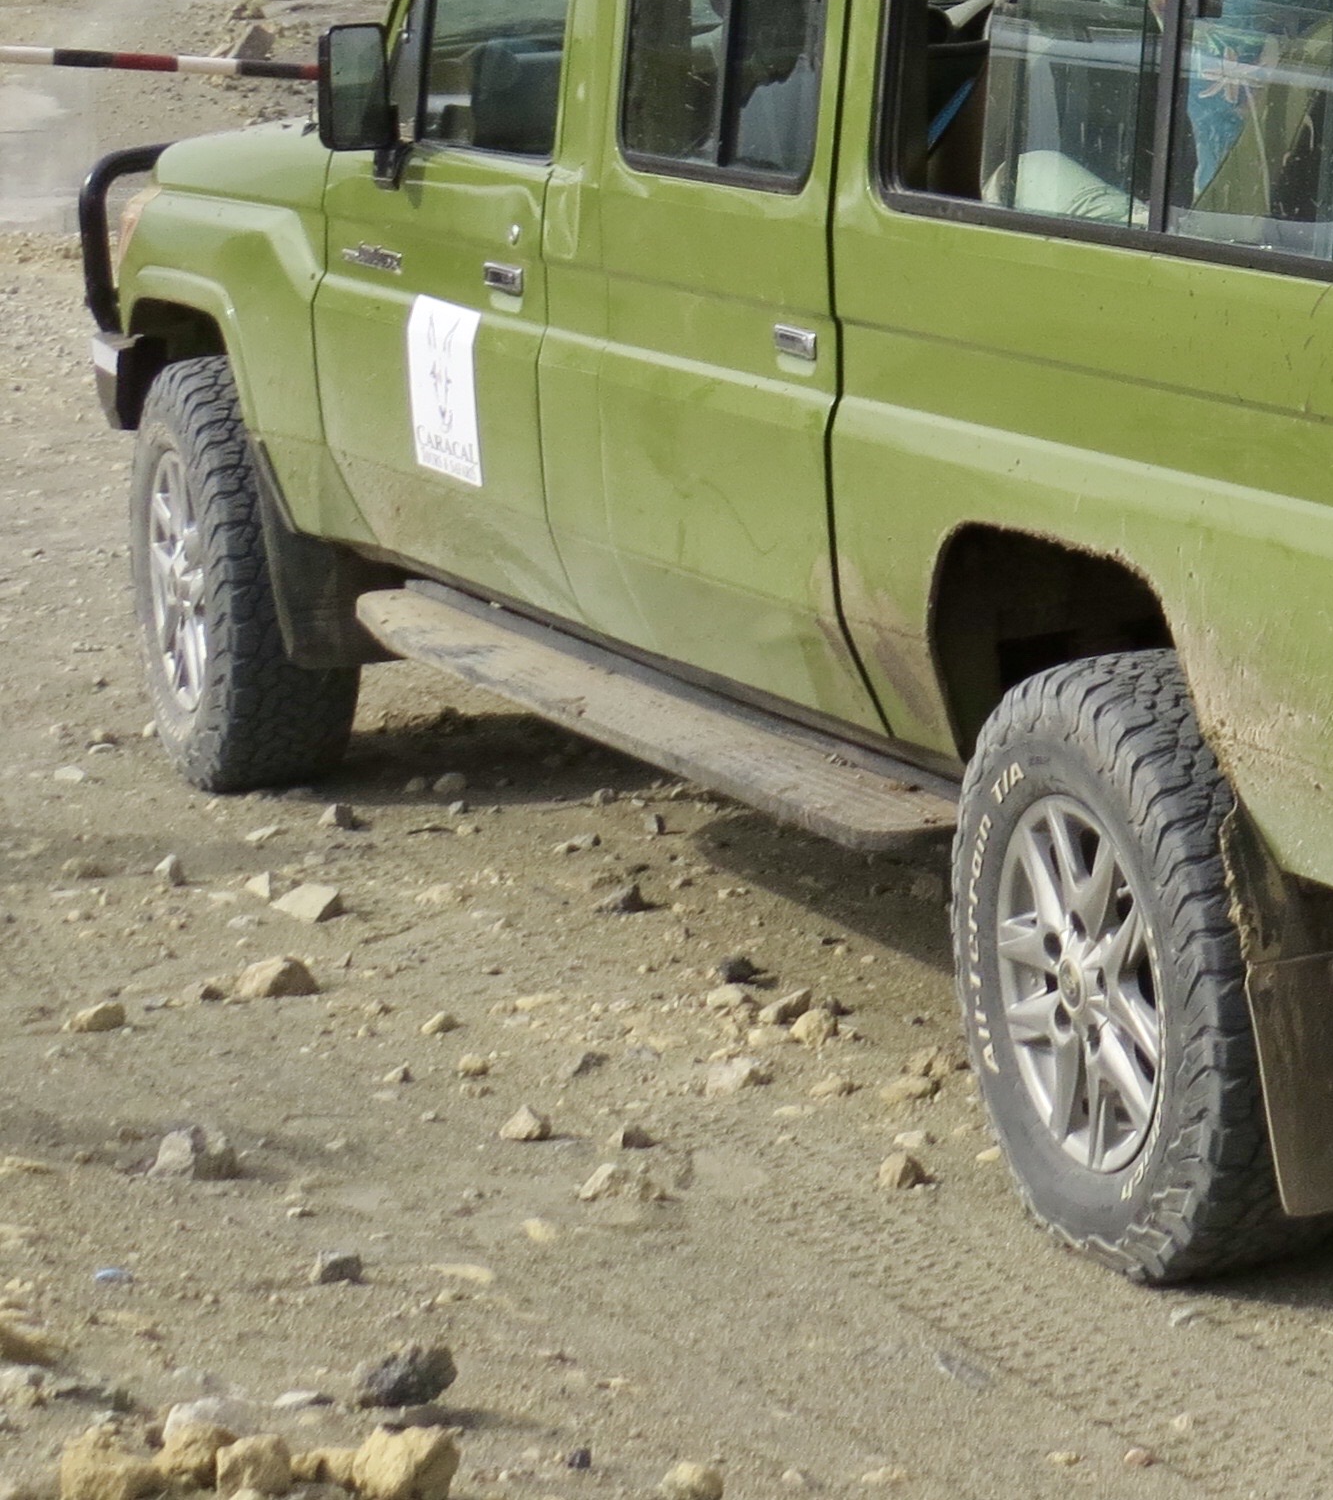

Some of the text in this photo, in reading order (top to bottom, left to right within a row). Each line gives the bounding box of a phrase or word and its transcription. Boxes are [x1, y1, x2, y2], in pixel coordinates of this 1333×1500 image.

[416, 424, 478, 465] CARACAL
[990, 761, 1025, 804] T/A
[968, 813, 1000, 1074] All-Terrain
